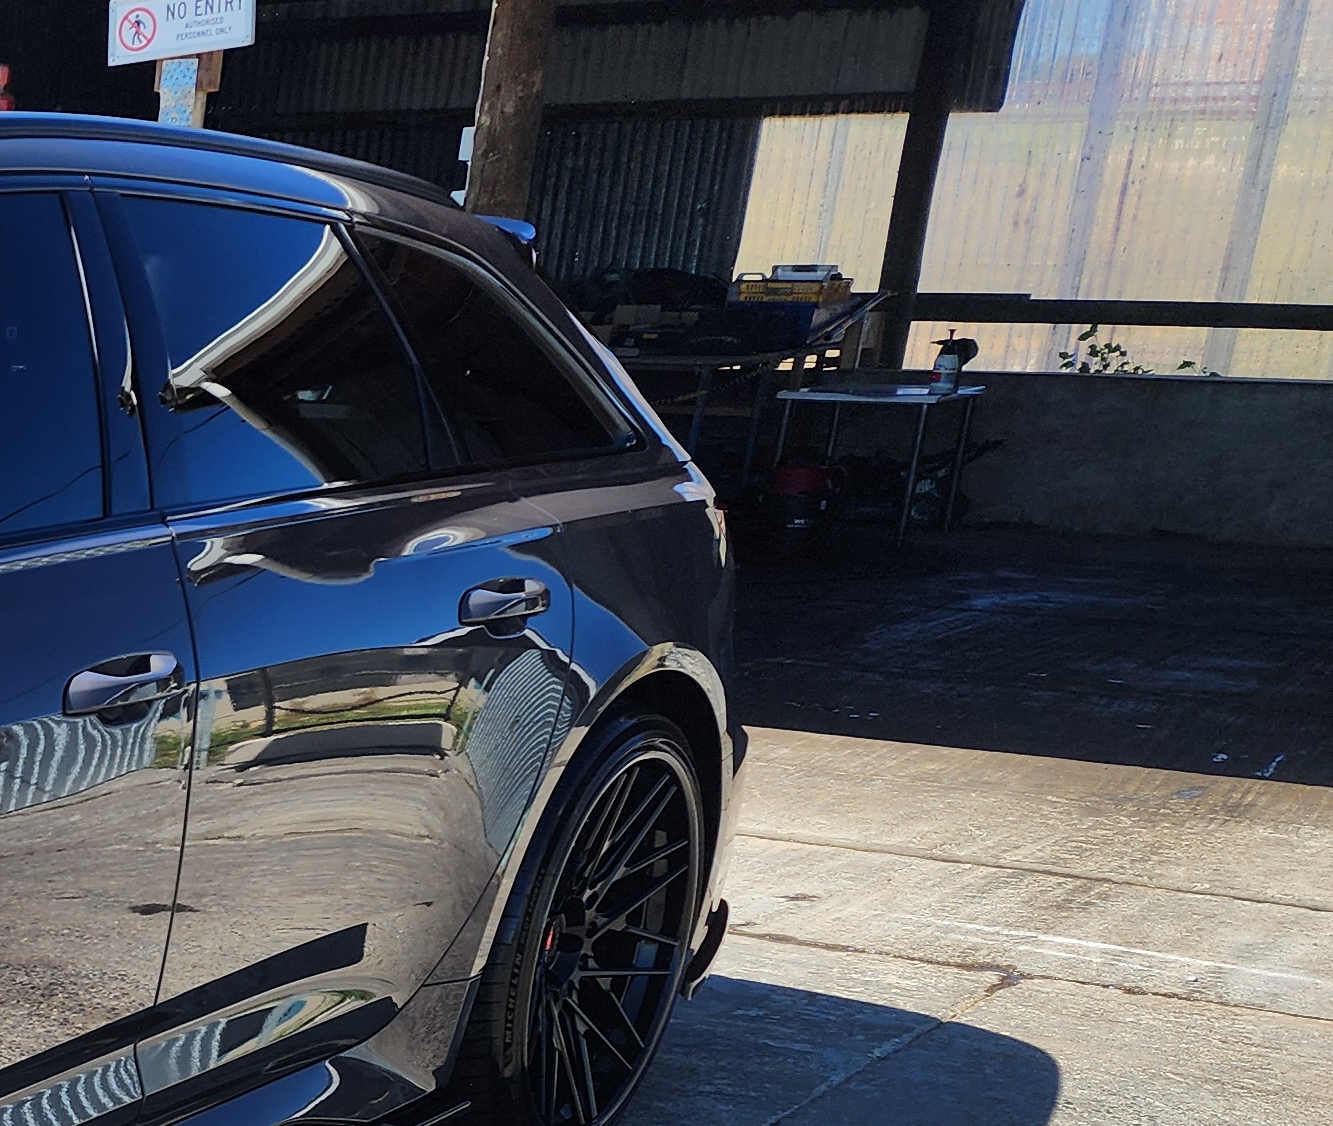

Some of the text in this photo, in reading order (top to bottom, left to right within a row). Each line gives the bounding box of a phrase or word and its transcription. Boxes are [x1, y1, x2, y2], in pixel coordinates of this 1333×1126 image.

[166, 1, 187, 21] NO
[184, 16, 224, 29] AUTHORISED
[176, 26, 233, 41] PERSONNEL ONLY
[504, 952, 522, 1044] MICHELIN
